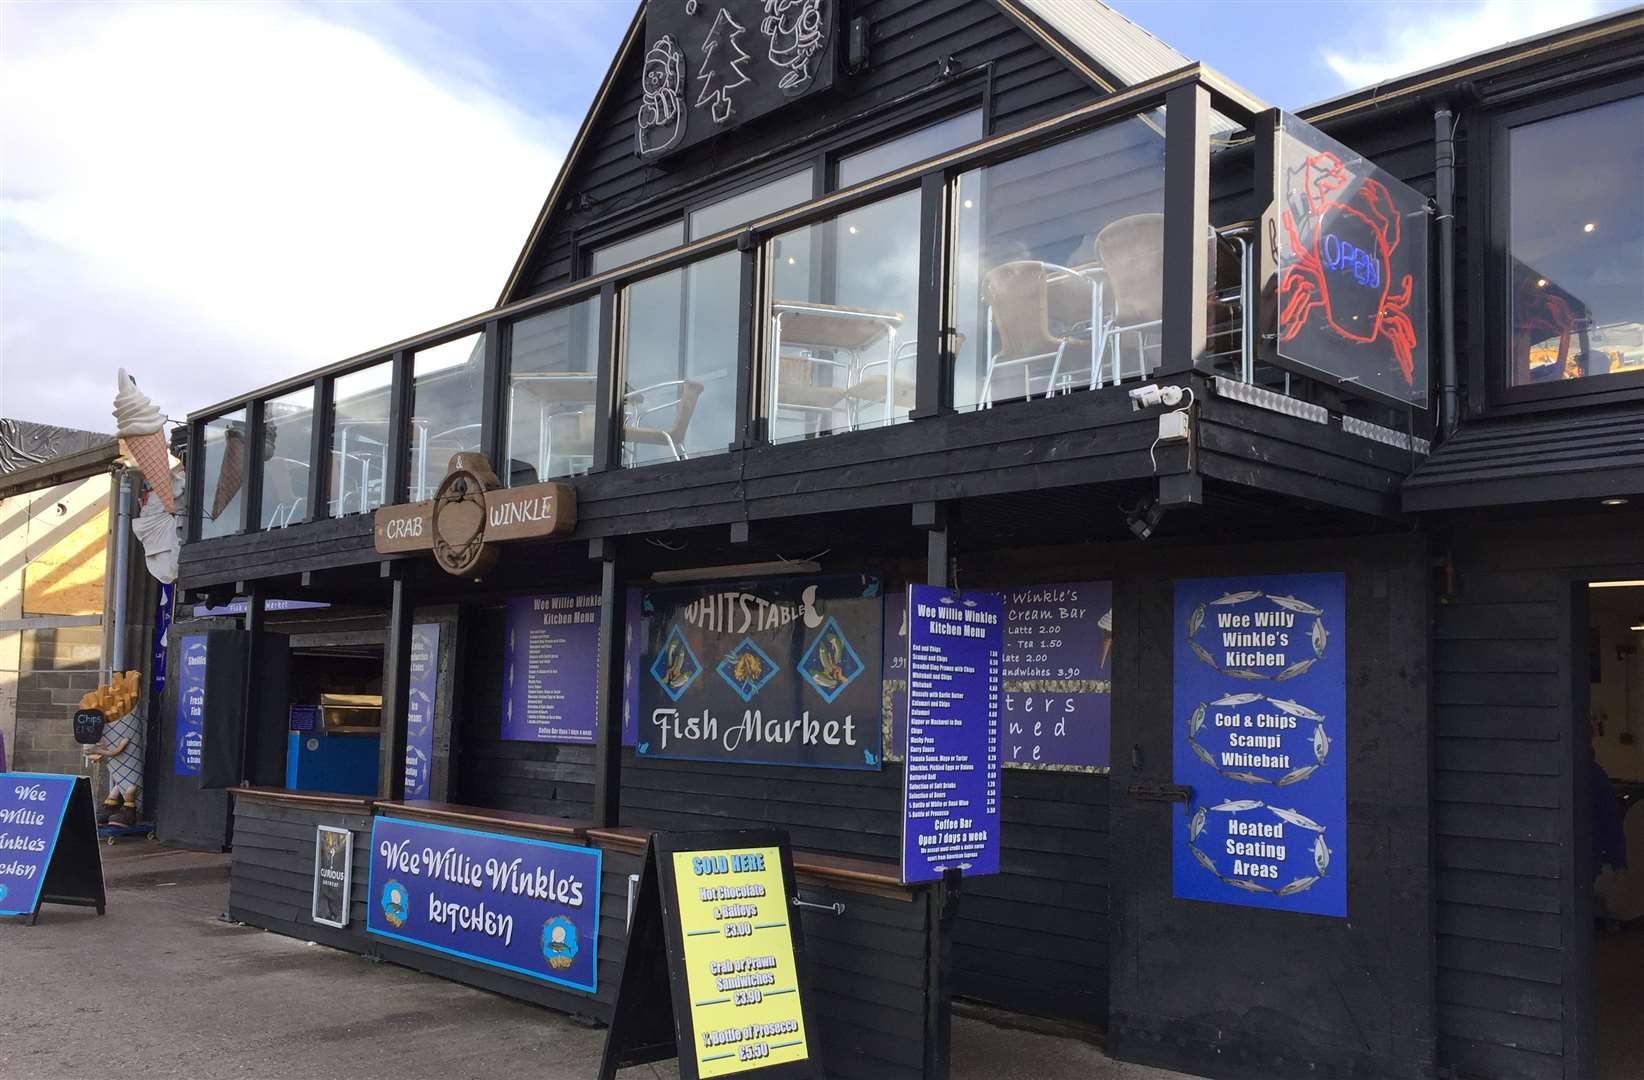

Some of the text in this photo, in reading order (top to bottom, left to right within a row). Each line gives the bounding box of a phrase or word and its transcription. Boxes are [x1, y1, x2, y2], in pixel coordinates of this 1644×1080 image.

[1324, 233, 1380, 288] OPEN
[386, 455, 553, 539] CRAB & WINKLE
[576, 594, 602, 608] Winkle
[1013, 589, 1078, 604] Winkle's
[543, 611, 595, 625] Kitchen Menu
[684, 592, 806, 634] WHITSTABLE
[917, 604, 998, 625] Wee Willie Winkles
[1008, 607, 1086, 621] Cream Bar
[1217, 611, 1295, 630] Wee Willy
[930, 621, 986, 639] Kitchen Menu
[1008, 626, 1061, 635] Latte 2.00
[1017, 640, 1062, 648] Tea 1.50
[1222, 631, 1289, 648] Winkle's
[1002, 653, 1048, 663] late 2.00
[1226, 651, 1286, 667] Kitchen
[1002, 667, 1080, 679] andwiches 3.90
[1005, 694, 1076, 713] ters
[77, 714, 102, 727] Chips
[1009, 717, 1066, 737] ned
[1215, 713, 1297, 730] Cod & Chips
[652, 708, 857, 752] Fish Market
[1229, 732, 1281, 750] Scampi
[1221, 752, 1290, 769] Whitebait
[15, 784, 47, 801] Wee
[0, 807, 45, 826] Willie
[934, 818, 973, 831] Coffee Bar
[918, 830, 988, 846] Open 7 days a week
[1228, 819, 1284, 839] Heated
[0, 832, 46, 852] inkle's
[1226, 839, 1286, 860] Seating
[0, 860, 37, 880] CHEN
[380, 839, 584, 906] Wee Willie Winkle's
[692, 853, 766, 876] SOLD HERE
[1233, 859, 1279, 879] Areas
[699, 884, 765, 902] Hot Chocolate
[713, 904, 758, 920] & Baileys
[724, 922, 752, 938] £3.00
[710, 955, 776, 977] Crab or Prawn
[716, 972, 775, 992] Sandwiches
[733, 990, 762, 1006] £3.90
[711, 1028, 743, 1046] Bottle
[743, 1026, 753, 1041] of
[752, 1020, 798, 1039] Prosecco
[739, 1043, 770, 1061] £5.50
